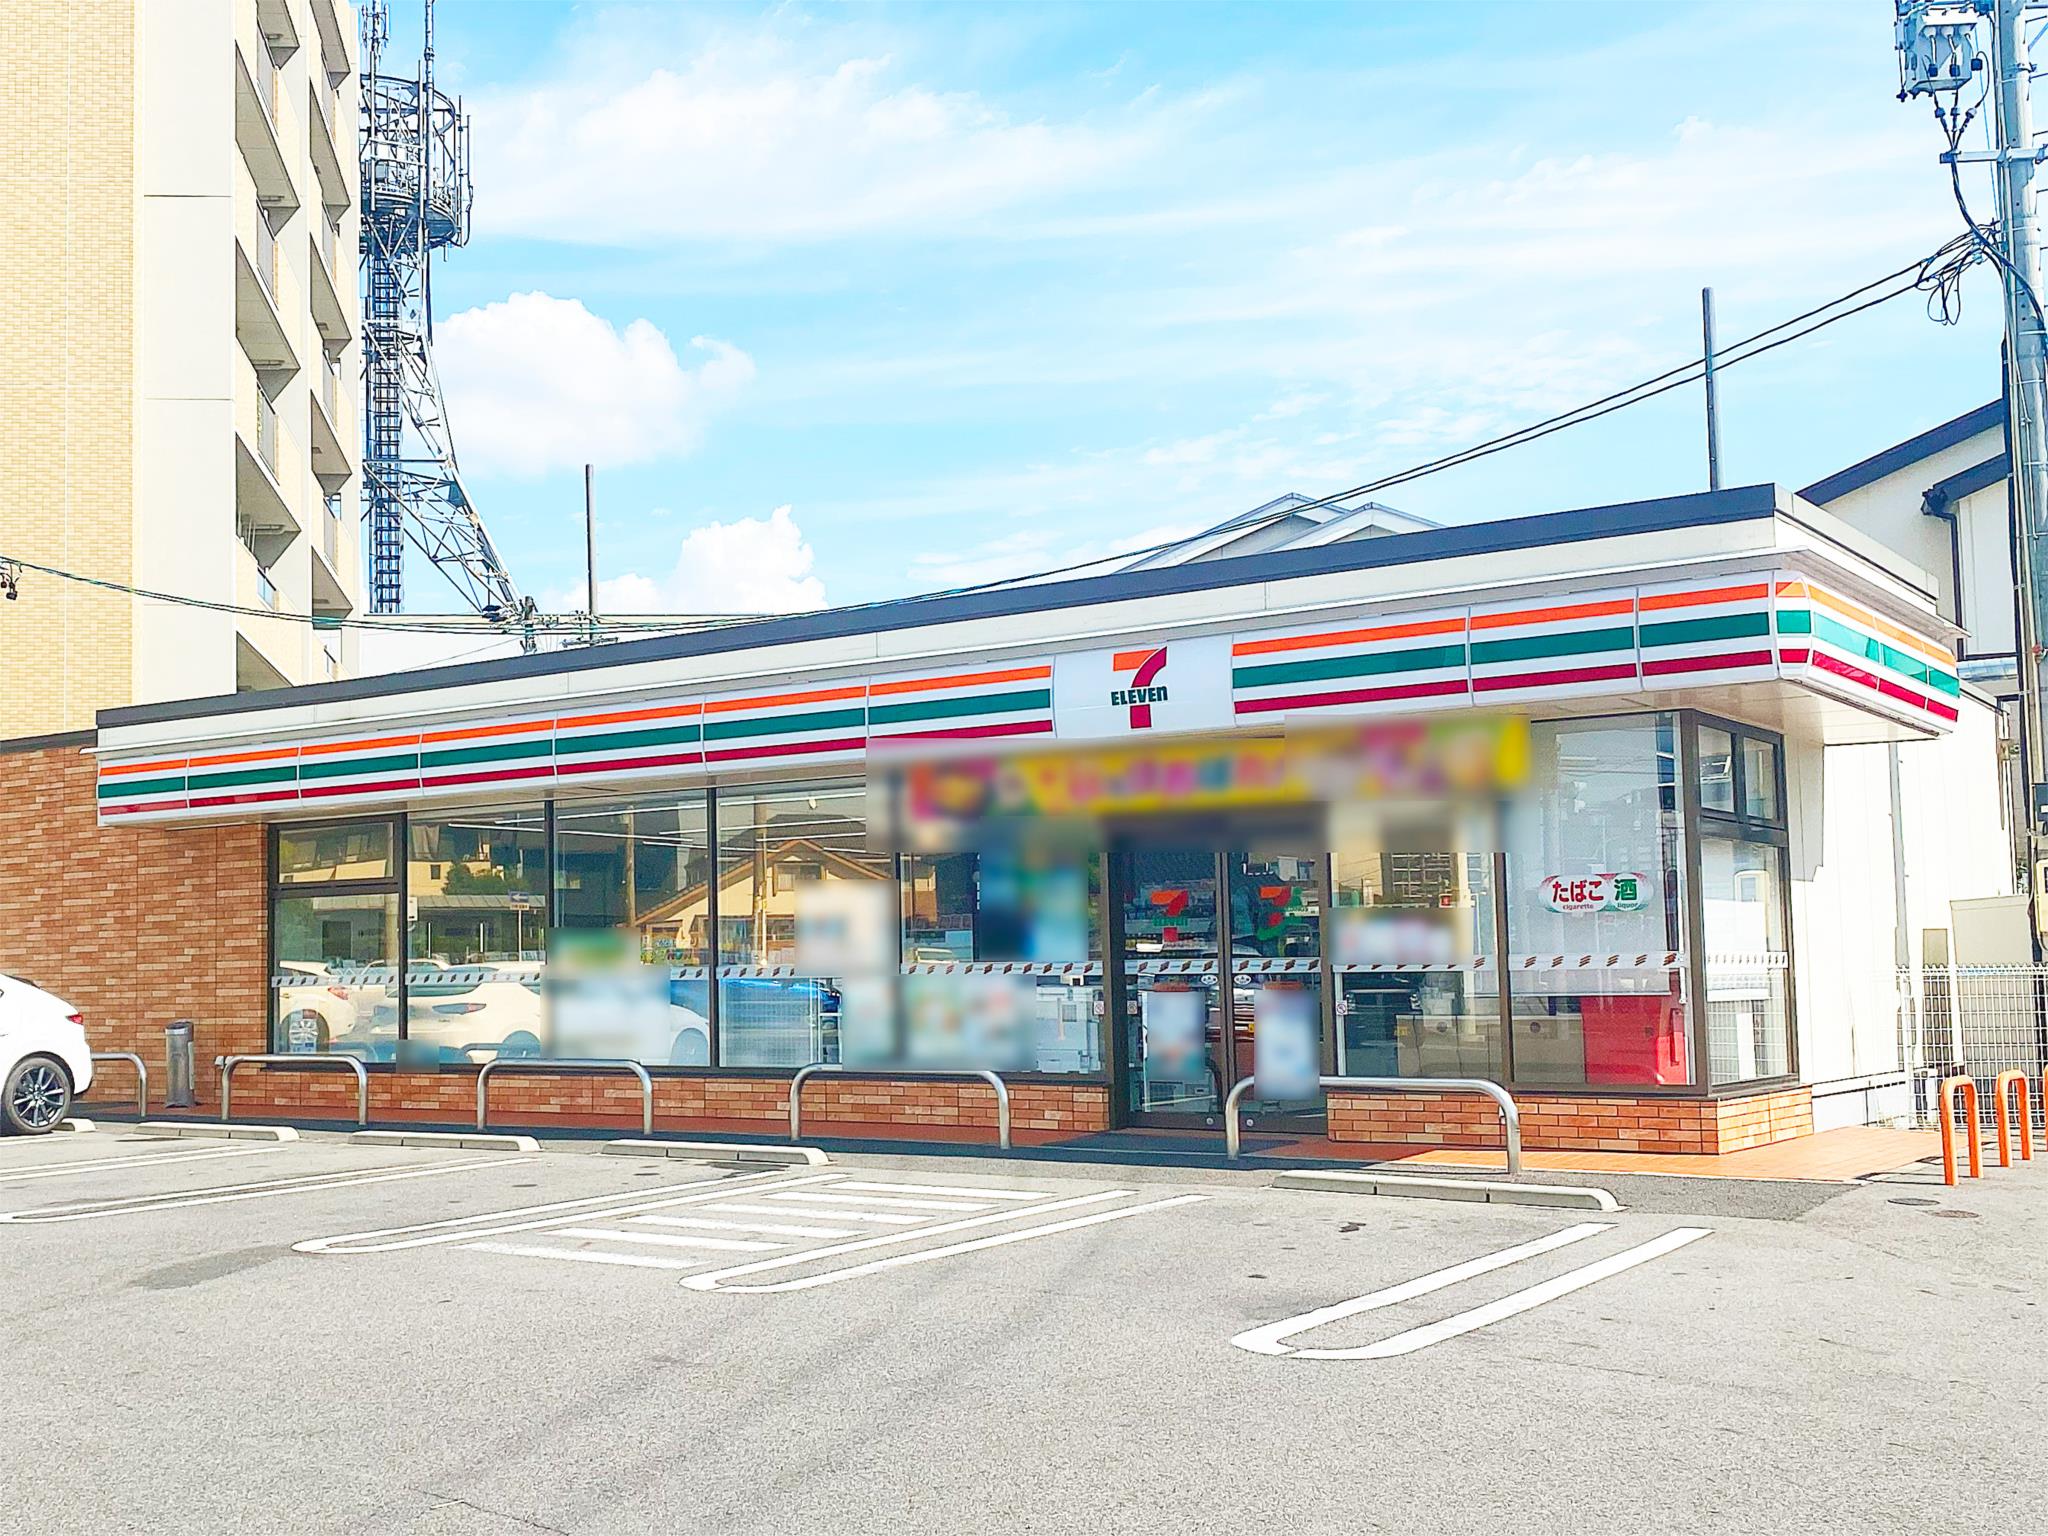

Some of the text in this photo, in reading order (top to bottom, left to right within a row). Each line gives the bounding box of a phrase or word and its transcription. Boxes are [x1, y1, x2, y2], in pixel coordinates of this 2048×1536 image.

[1113, 646, 1167, 729] 7
[1552, 879, 1637, 902] たばこ 酒
[1562, 903, 1594, 911] cigarette
